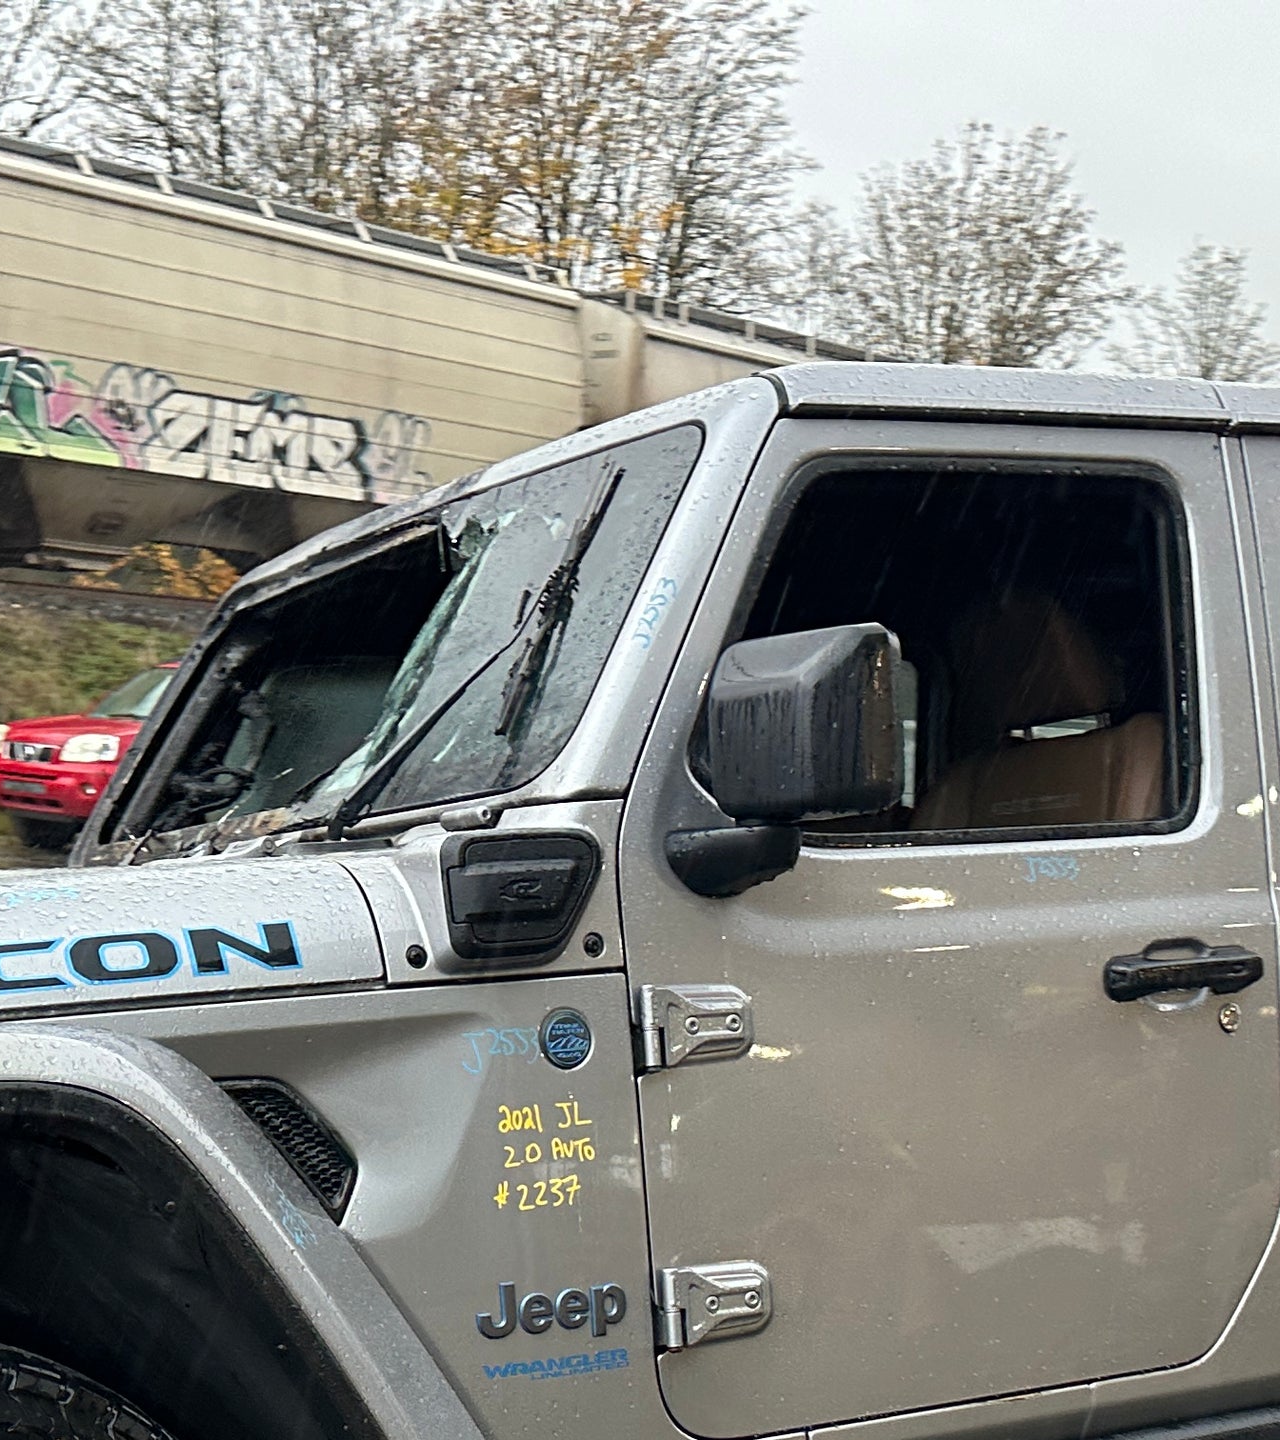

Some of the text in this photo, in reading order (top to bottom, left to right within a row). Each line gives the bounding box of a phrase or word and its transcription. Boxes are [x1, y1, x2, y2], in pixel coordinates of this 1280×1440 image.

[462, 1027, 541, 1074] J2553
[498, 1101, 593, 1133] 2021 JL
[475, 1281, 626, 1339] Jeep
[482, 1348, 629, 1380] WRANGLER
